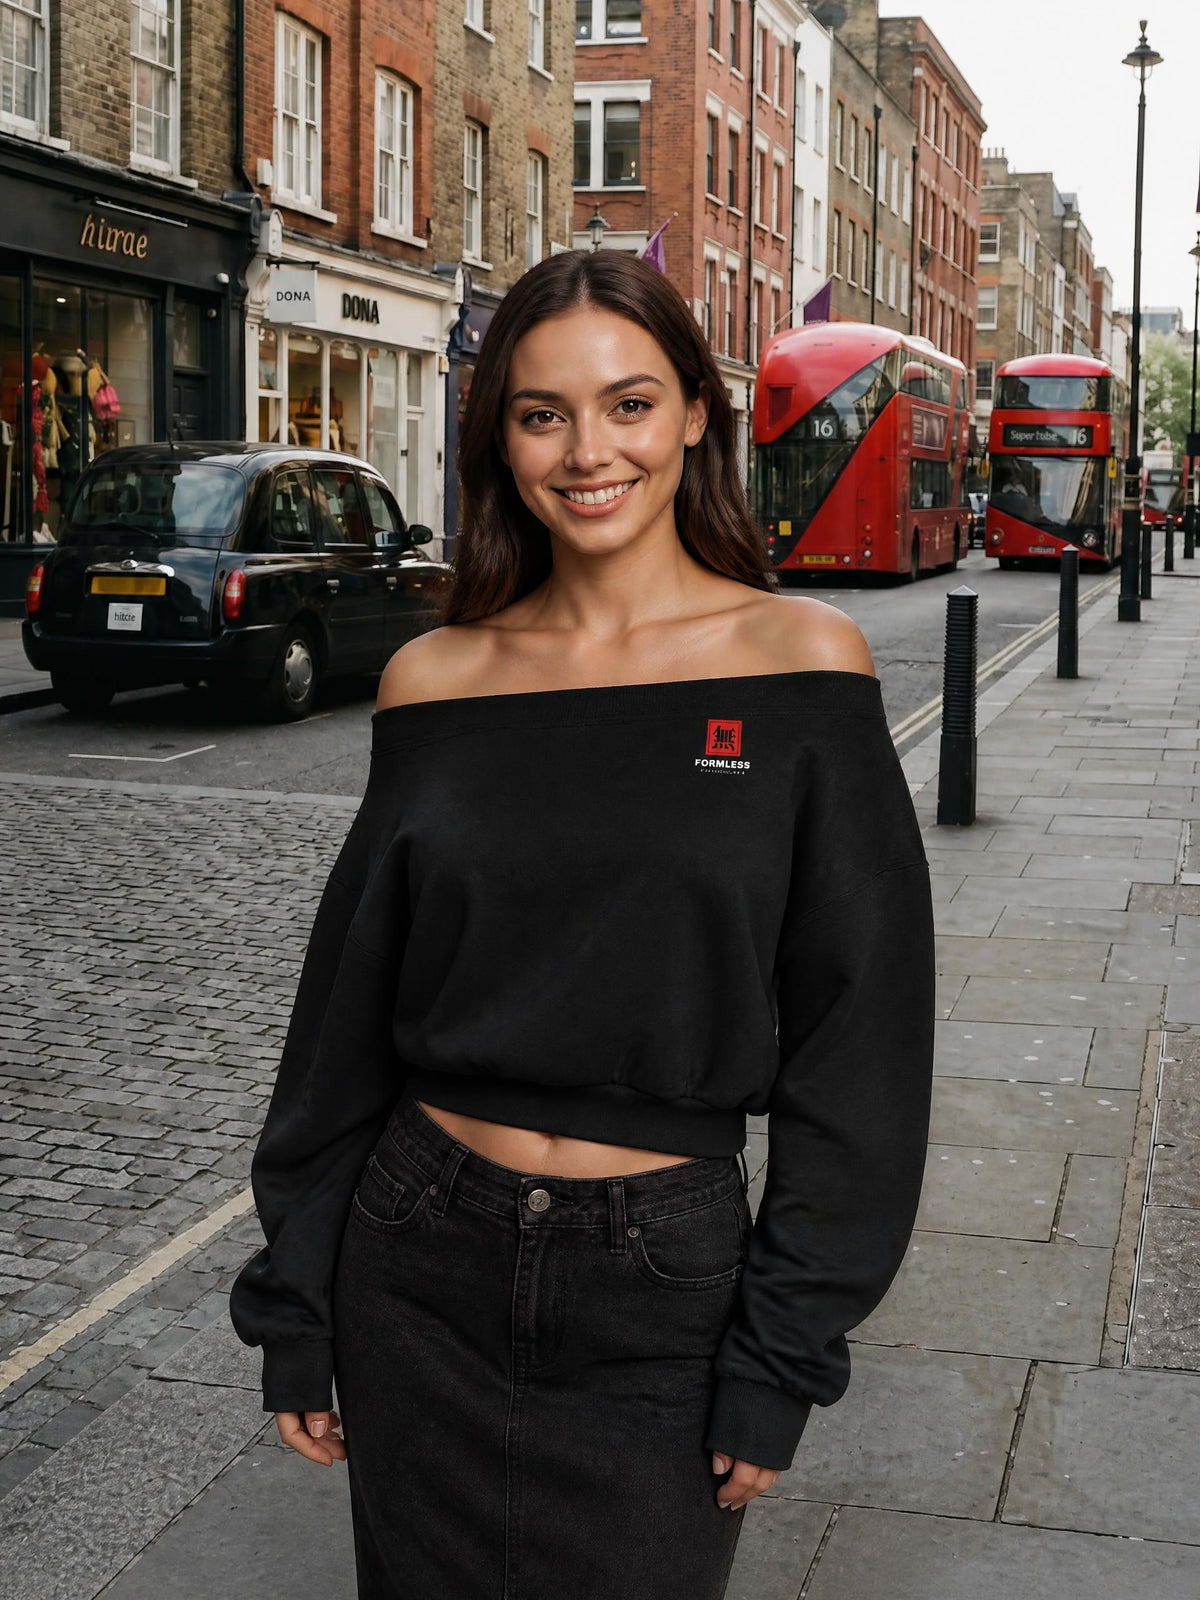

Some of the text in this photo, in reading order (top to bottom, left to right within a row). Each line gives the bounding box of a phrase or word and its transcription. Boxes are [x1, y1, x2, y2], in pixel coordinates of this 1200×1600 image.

[276, 291, 311, 302] DONA
[342, 293, 380, 324] DONA
[813, 419, 834, 437] 16
[1072, 428, 1088, 445] 16
[694, 758, 751, 769] FORMLESS
